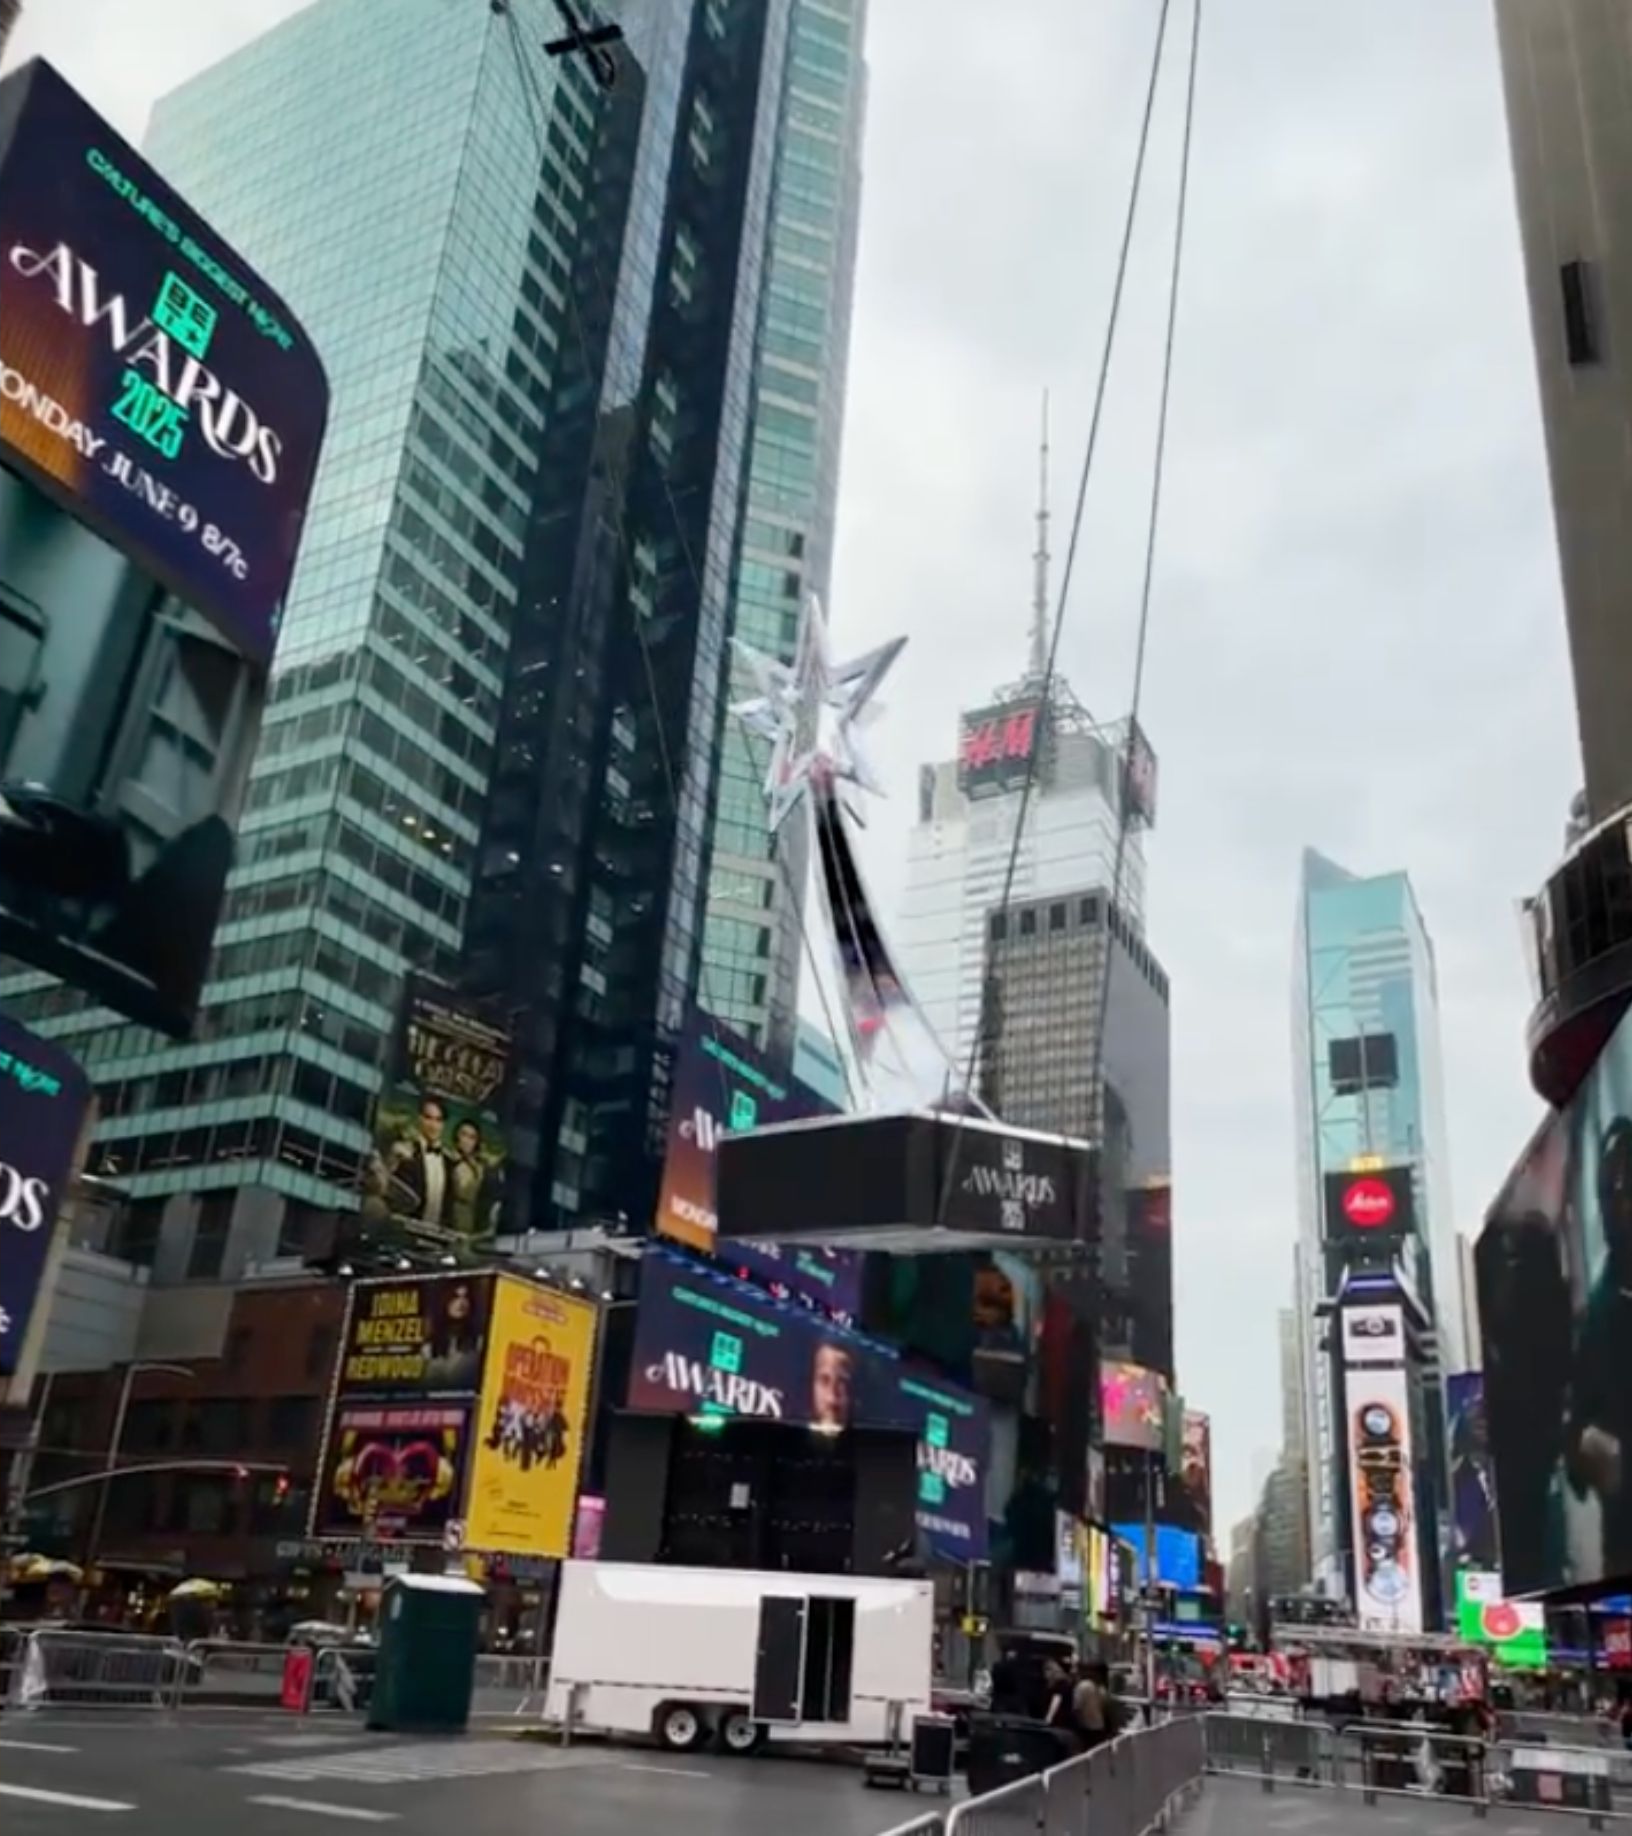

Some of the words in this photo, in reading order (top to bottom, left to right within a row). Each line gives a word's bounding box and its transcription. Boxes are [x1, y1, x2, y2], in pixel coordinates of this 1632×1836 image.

[9, 239, 282, 485] AWARDS
[0, 358, 107, 459] ONDAY
[100, 452, 180, 520] JUNE
[177, 502, 200, 533] 9
[110, 368, 190, 460] 2025
[961, 1164, 1057, 1210] AWARDS
[356, 1317, 425, 1346] MENZEL
[645, 1351, 784, 1419] AWARDS
